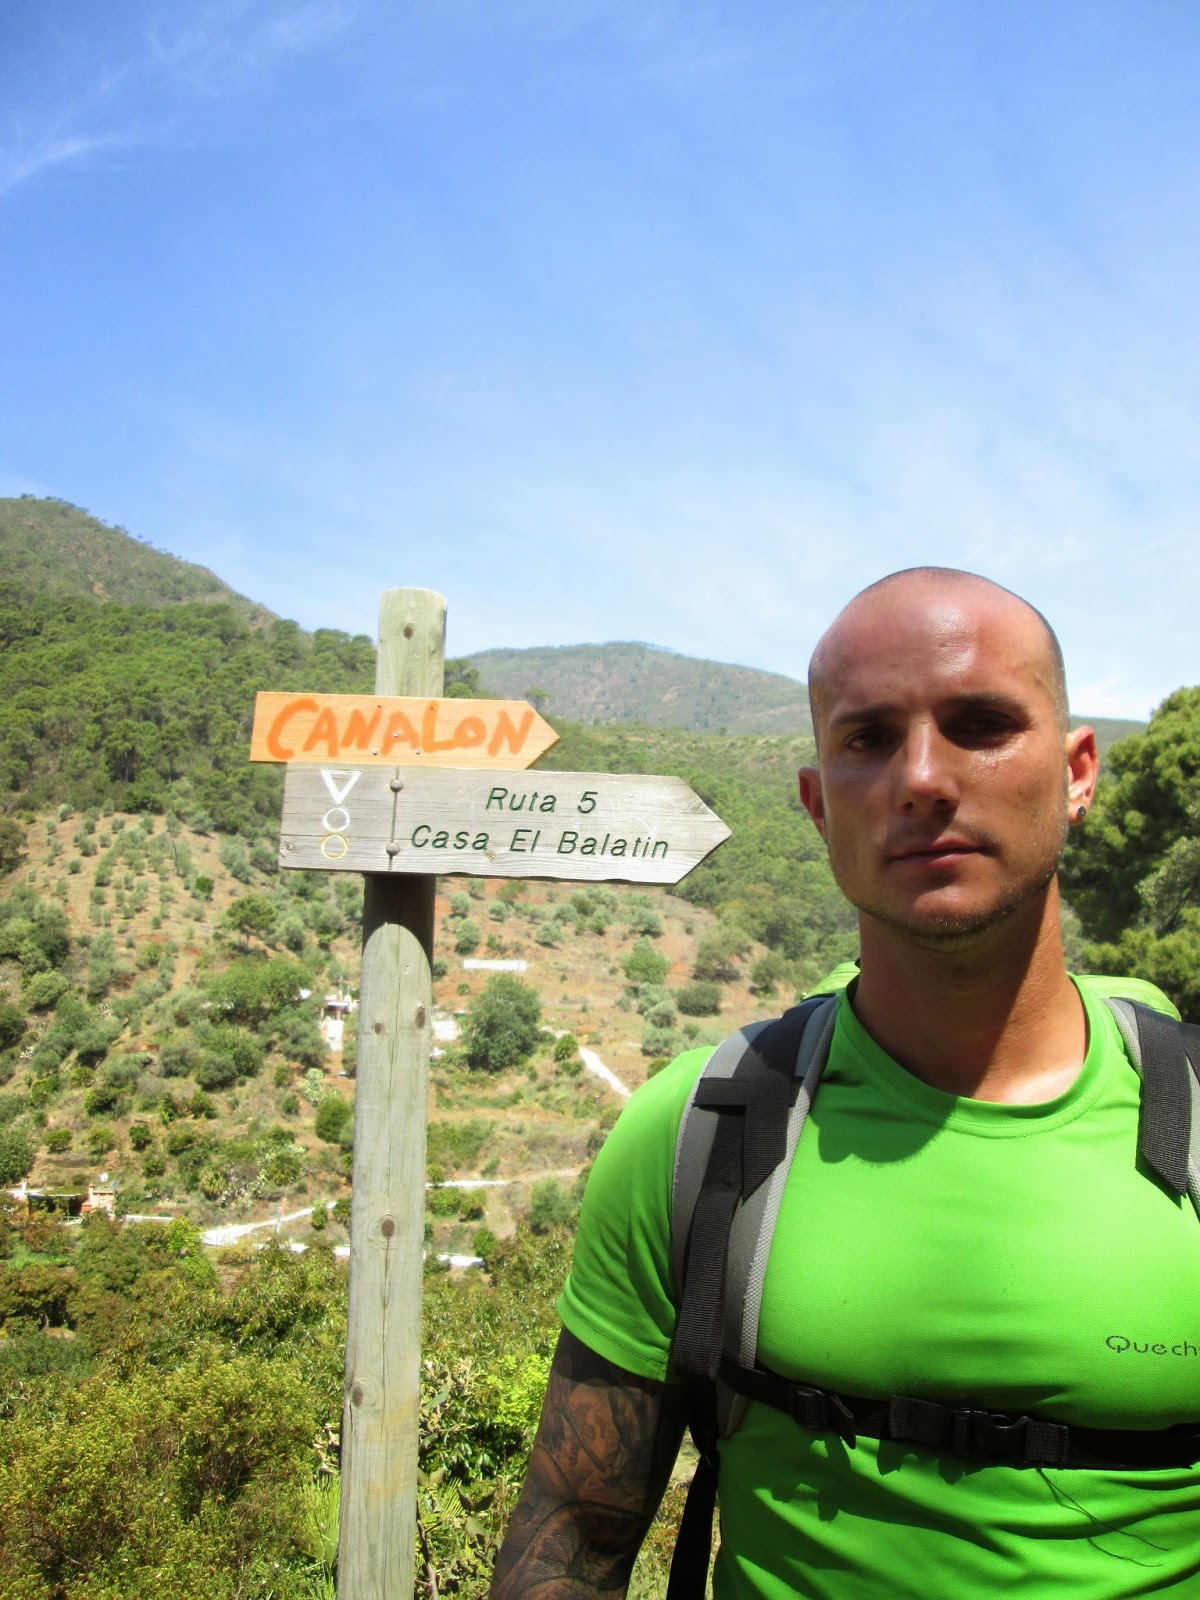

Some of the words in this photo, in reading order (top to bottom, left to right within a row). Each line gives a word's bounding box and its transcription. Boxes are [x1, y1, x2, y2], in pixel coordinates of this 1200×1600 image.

[267, 699, 535, 760] CANALON
[485, 787, 557, 813] Ruta
[577, 790, 599, 814] 5
[411, 824, 490, 851] Casa
[509, 828, 541, 853] El
[557, 831, 669, 859] Balatin
[1105, 1335, 1200, 1356] Quech
